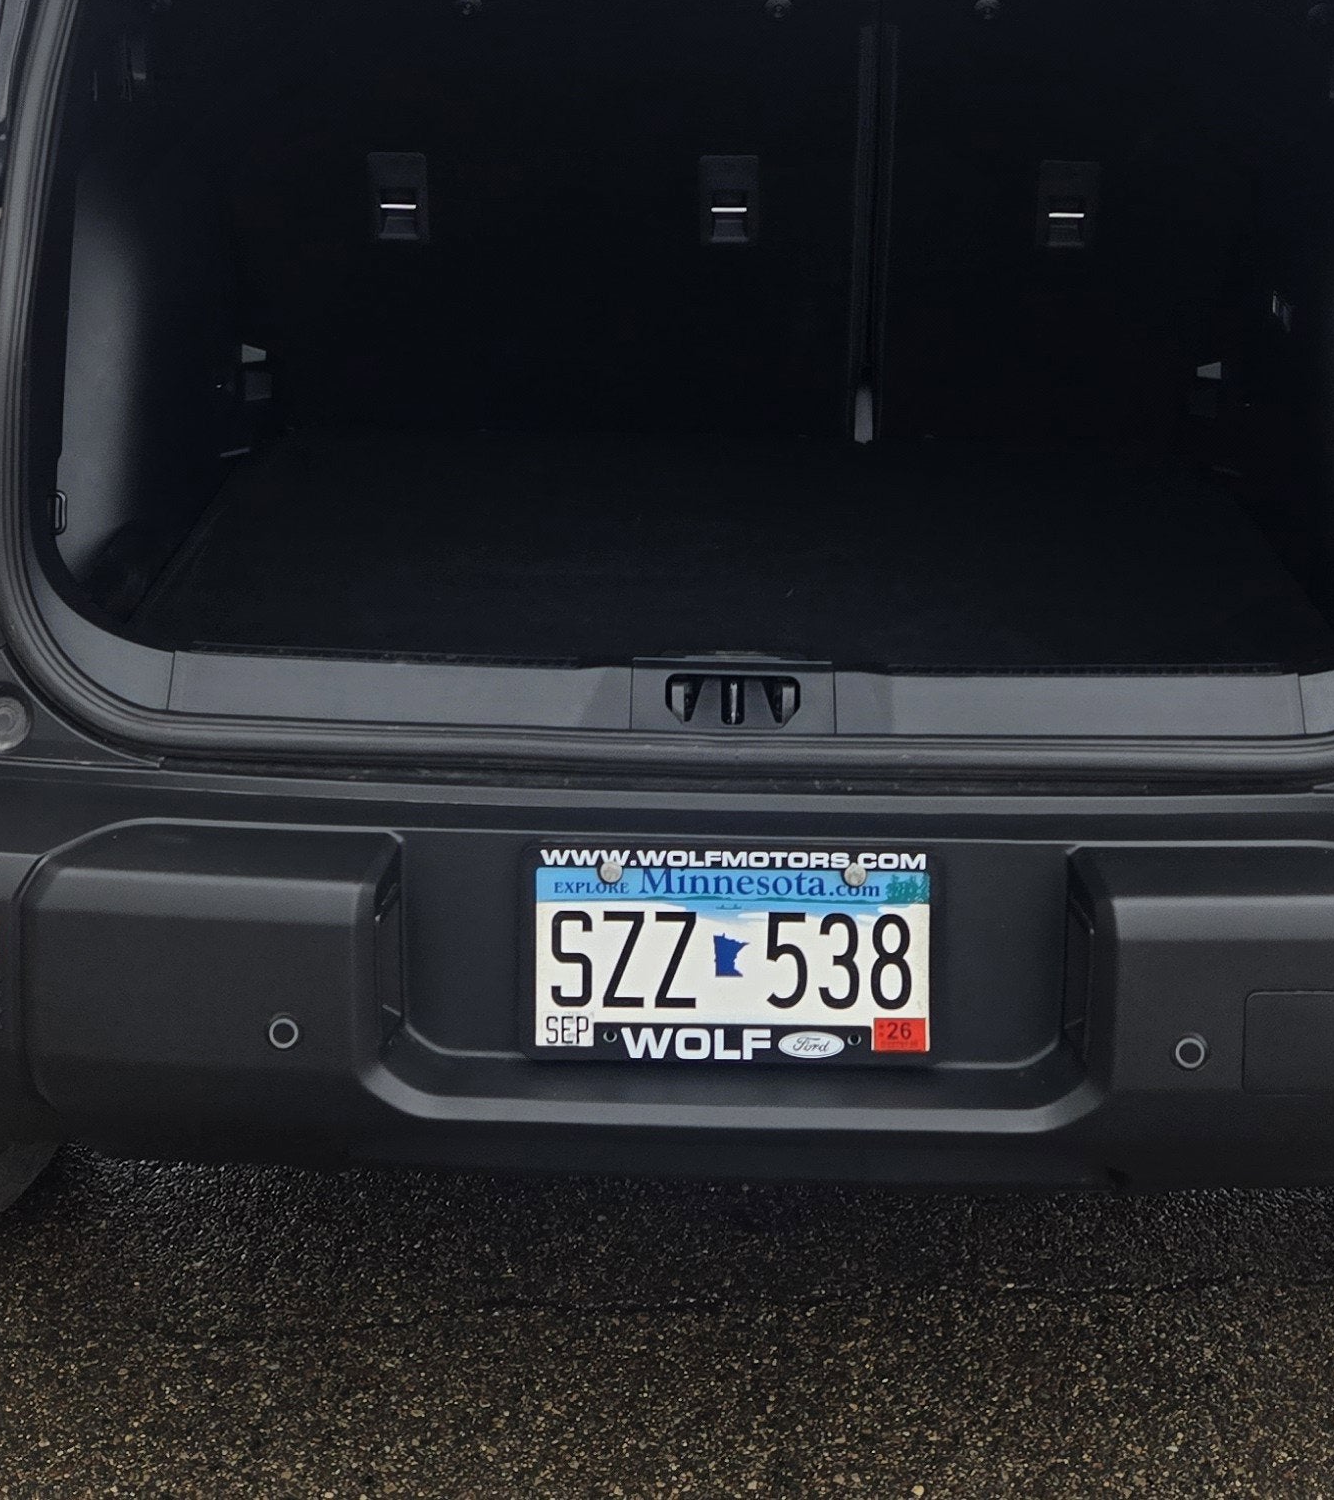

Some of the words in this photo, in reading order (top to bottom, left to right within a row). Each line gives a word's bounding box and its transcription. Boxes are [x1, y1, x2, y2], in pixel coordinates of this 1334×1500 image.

[553, 881, 630, 895] EXPLORE
[551, 910, 697, 1009] SZZ
[766, 912, 912, 1010] 538
[546, 1015, 589, 1045] SEP
[620, 1026, 772, 1061] WOLF
[793, 1036, 830, 1053] Ford
[887, 1022, 912, 1041] 26
